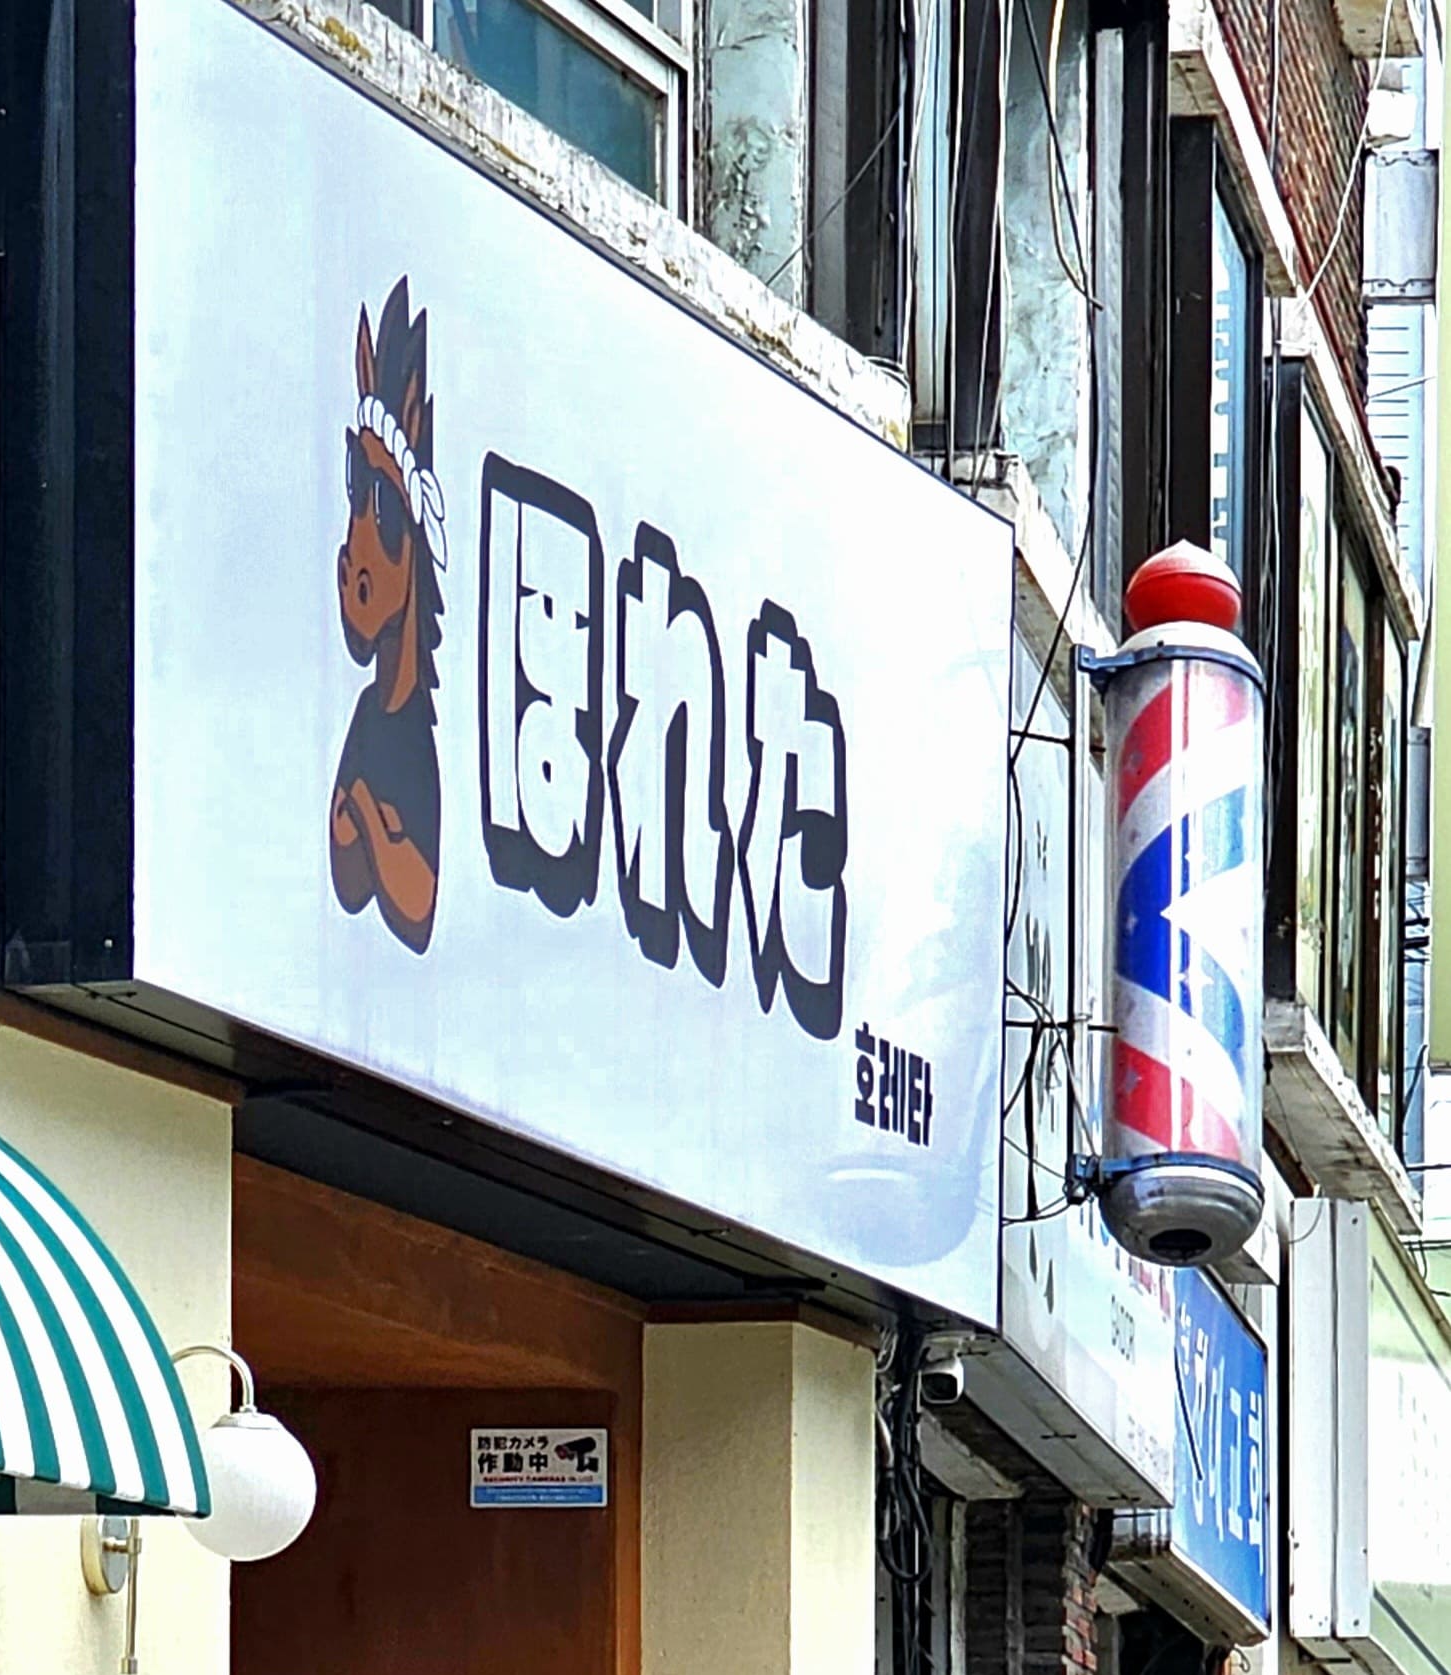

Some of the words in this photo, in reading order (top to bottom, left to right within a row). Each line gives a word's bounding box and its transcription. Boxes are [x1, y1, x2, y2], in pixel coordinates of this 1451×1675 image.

[477, 450, 848, 1040] ほれた
[855, 1021, 933, 1147] 호레타
[478, 1436, 549, 1450] 防犯カメラ
[478, 1452, 548, 1473] 作動中
